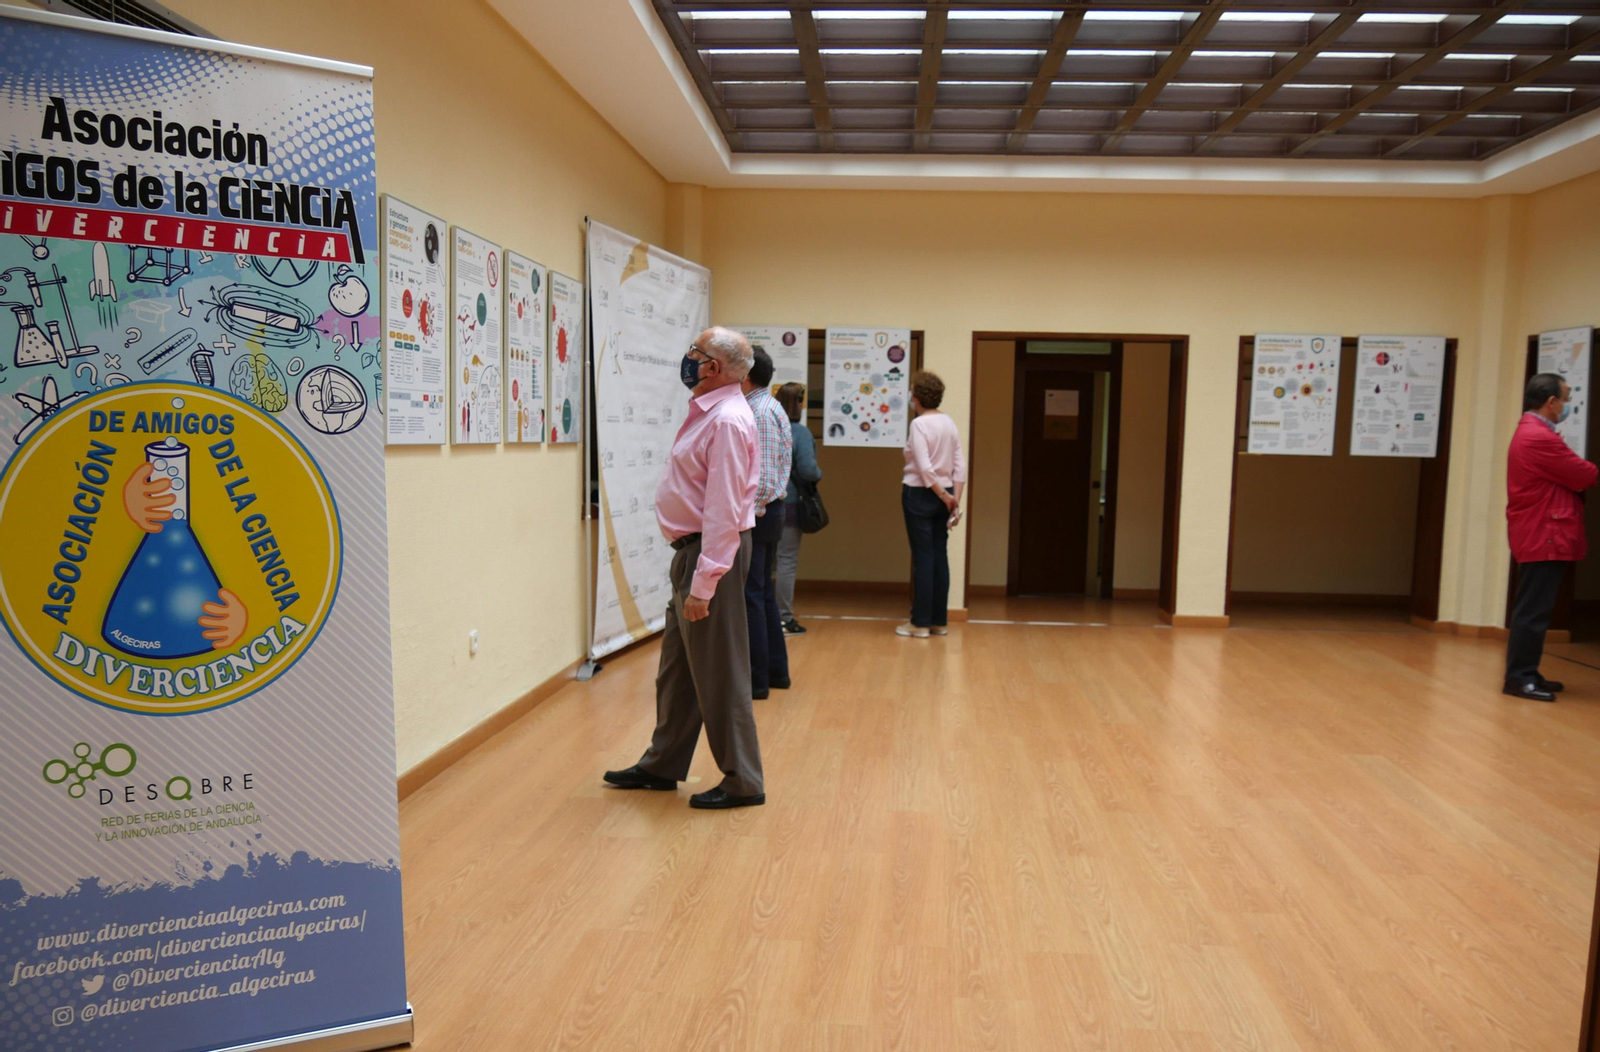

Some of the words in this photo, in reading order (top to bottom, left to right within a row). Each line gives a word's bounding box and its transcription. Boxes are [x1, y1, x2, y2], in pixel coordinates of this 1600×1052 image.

[41, 96, 269, 167] Asociación
[112, 165, 164, 211] de
[174, 170, 209, 216] la
[218, 176, 366, 264] CIENCIA
[88, 410, 126, 433] DE
[131, 411, 235, 435] AMIGOS
[208, 438, 244, 478] DE
[224, 476, 258, 514] LA
[42, 440, 117, 625] ASOCIACIÓN
[241, 513, 300, 612] CIENCIA
[53, 615, 306, 698] DIVERCIENCIA
[110, 629, 161, 649] ALGECIRAS
[95, 833, 102, 842] Y
[105, 830, 118, 841] LA
[121, 822, 187, 839] INNOVACIÓN
[189, 820, 203, 831] DE
[206, 814, 262, 829] ANDALUCÍA
[101, 817, 124, 828] RED
[127, 814, 141, 825] DE
[144, 810, 181, 822] FERIAS
[184, 808, 198, 818] DE
[200, 806, 213, 817] LA
[216, 801, 256, 814] CIENCIA
[36, 893, 347, 951] www.divercienciaalgeciras.com
[8, 909, 367, 988] facebook.com/divercienciaalgeciras/
[112, 948, 287, 993] @DivercienciaAlg
[80, 965, 317, 1022] @diverciencia_algeciras
